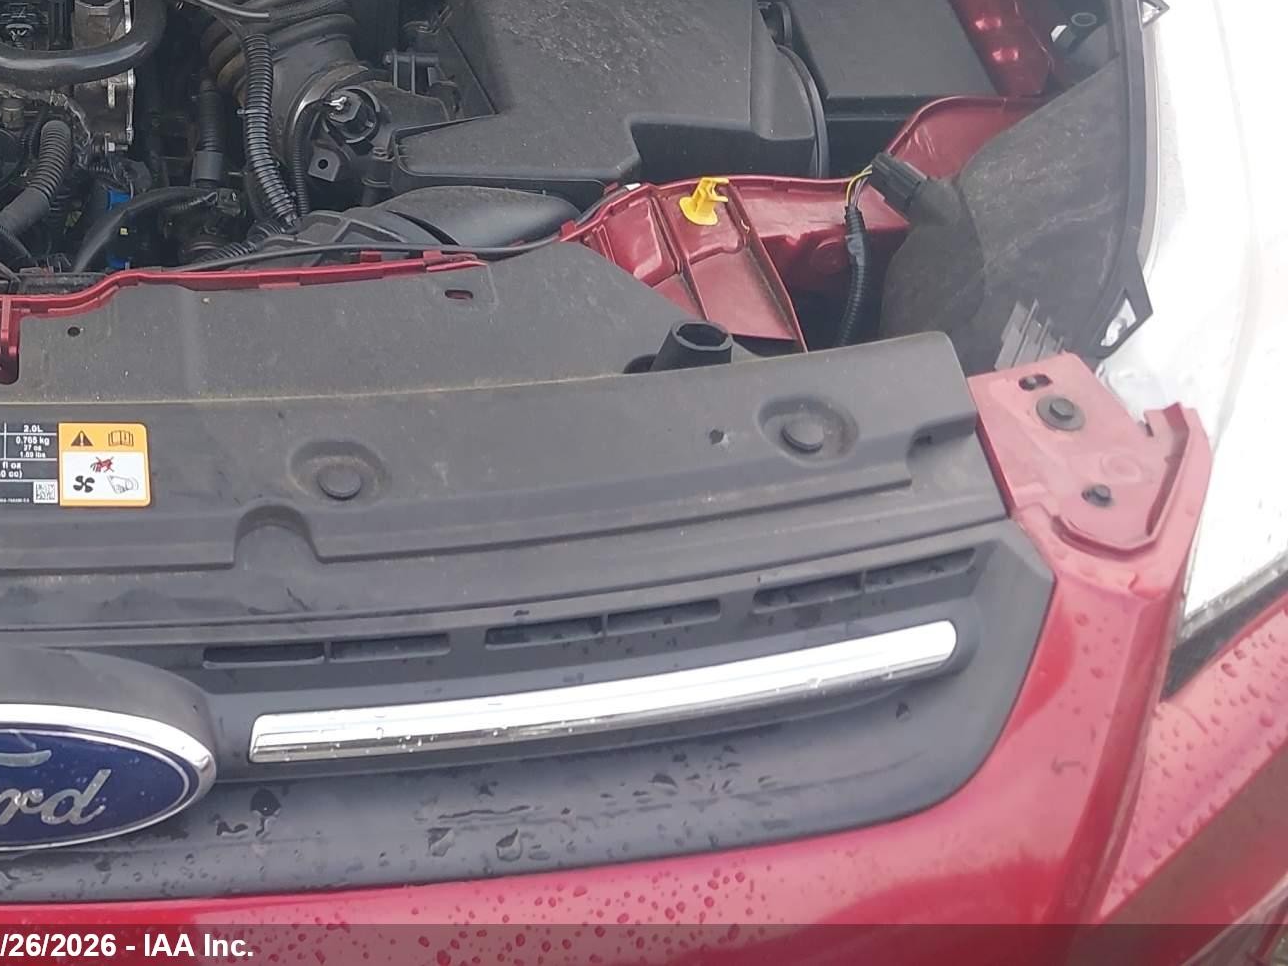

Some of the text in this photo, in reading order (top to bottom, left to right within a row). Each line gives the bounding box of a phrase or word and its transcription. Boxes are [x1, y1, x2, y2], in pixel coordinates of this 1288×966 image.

[23, 424, 43, 433] 2.0L
[39, 436, 50, 446] kg
[10, 462, 22, 470] oz
